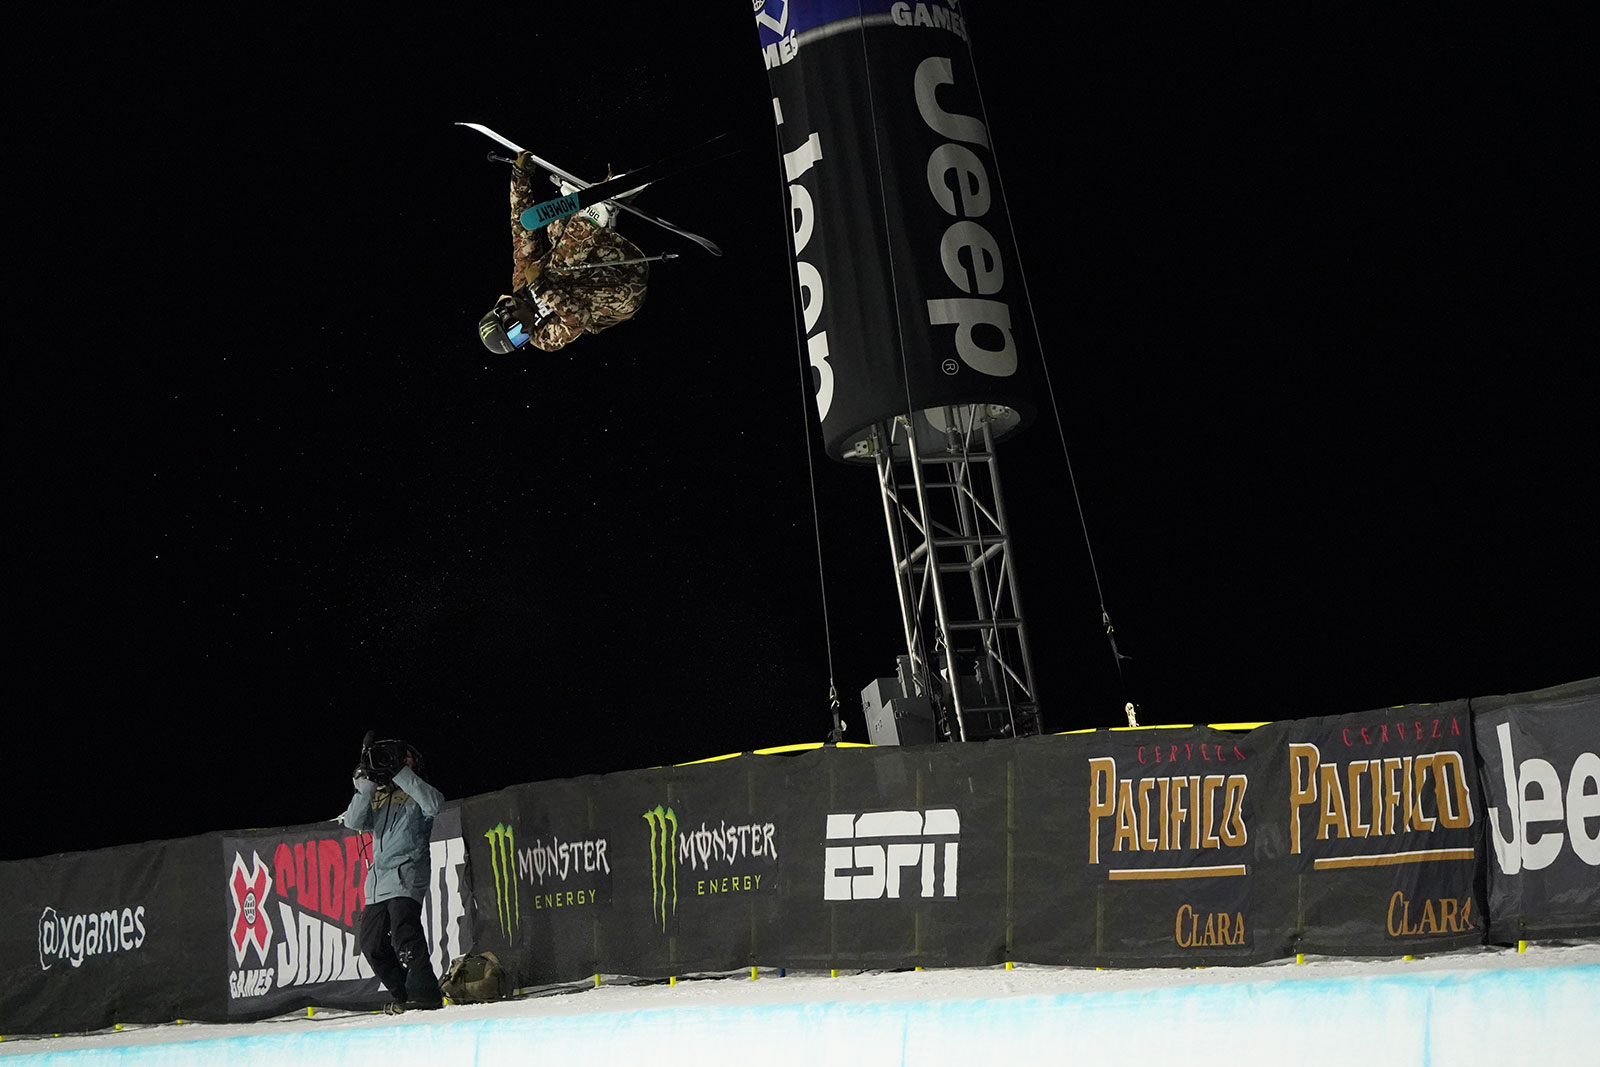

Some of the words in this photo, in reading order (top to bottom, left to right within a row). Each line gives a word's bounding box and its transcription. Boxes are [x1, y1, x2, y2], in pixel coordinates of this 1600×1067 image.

[536, 196, 576, 222] MOMENT
[913, 56, 1018, 378] Jeep
[1342, 717, 1461, 747] CERVEZA
[1137, 743, 1247, 764] CERVEZA
[517, 836, 611, 885] MONSTER
[678, 819, 778, 871] MONSTER
[823, 808, 961, 902] ESPN
[535, 889, 597, 910] ENERGY
[697, 874, 762, 896] ENERGY
[38, 905, 146, 971] @xgames
[1175, 903, 1245, 948] CLARA
[229, 968, 275, 1000] GAMES
